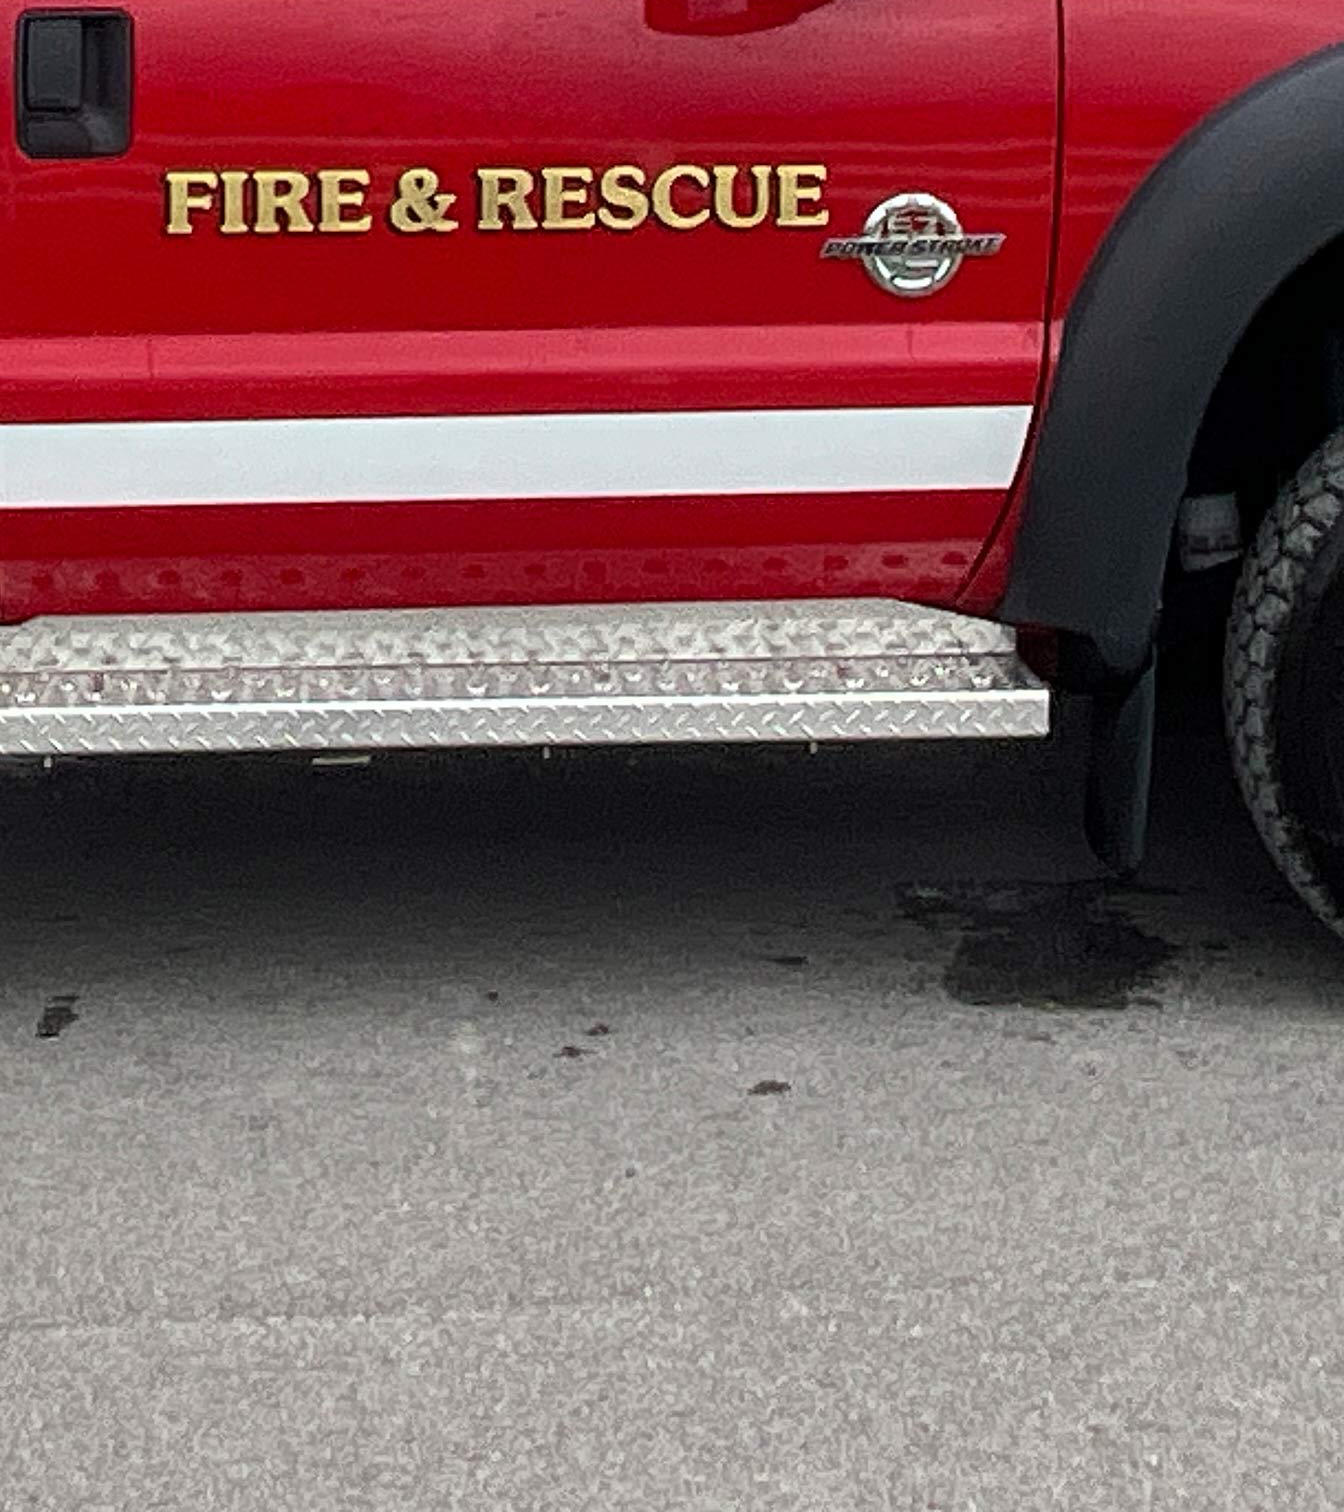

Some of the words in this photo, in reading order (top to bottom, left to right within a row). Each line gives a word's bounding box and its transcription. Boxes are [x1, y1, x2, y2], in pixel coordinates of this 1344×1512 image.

[164, 169, 372, 235] FIRE
[389, 168, 459, 233] &
[476, 164, 830, 231] RESCUE
